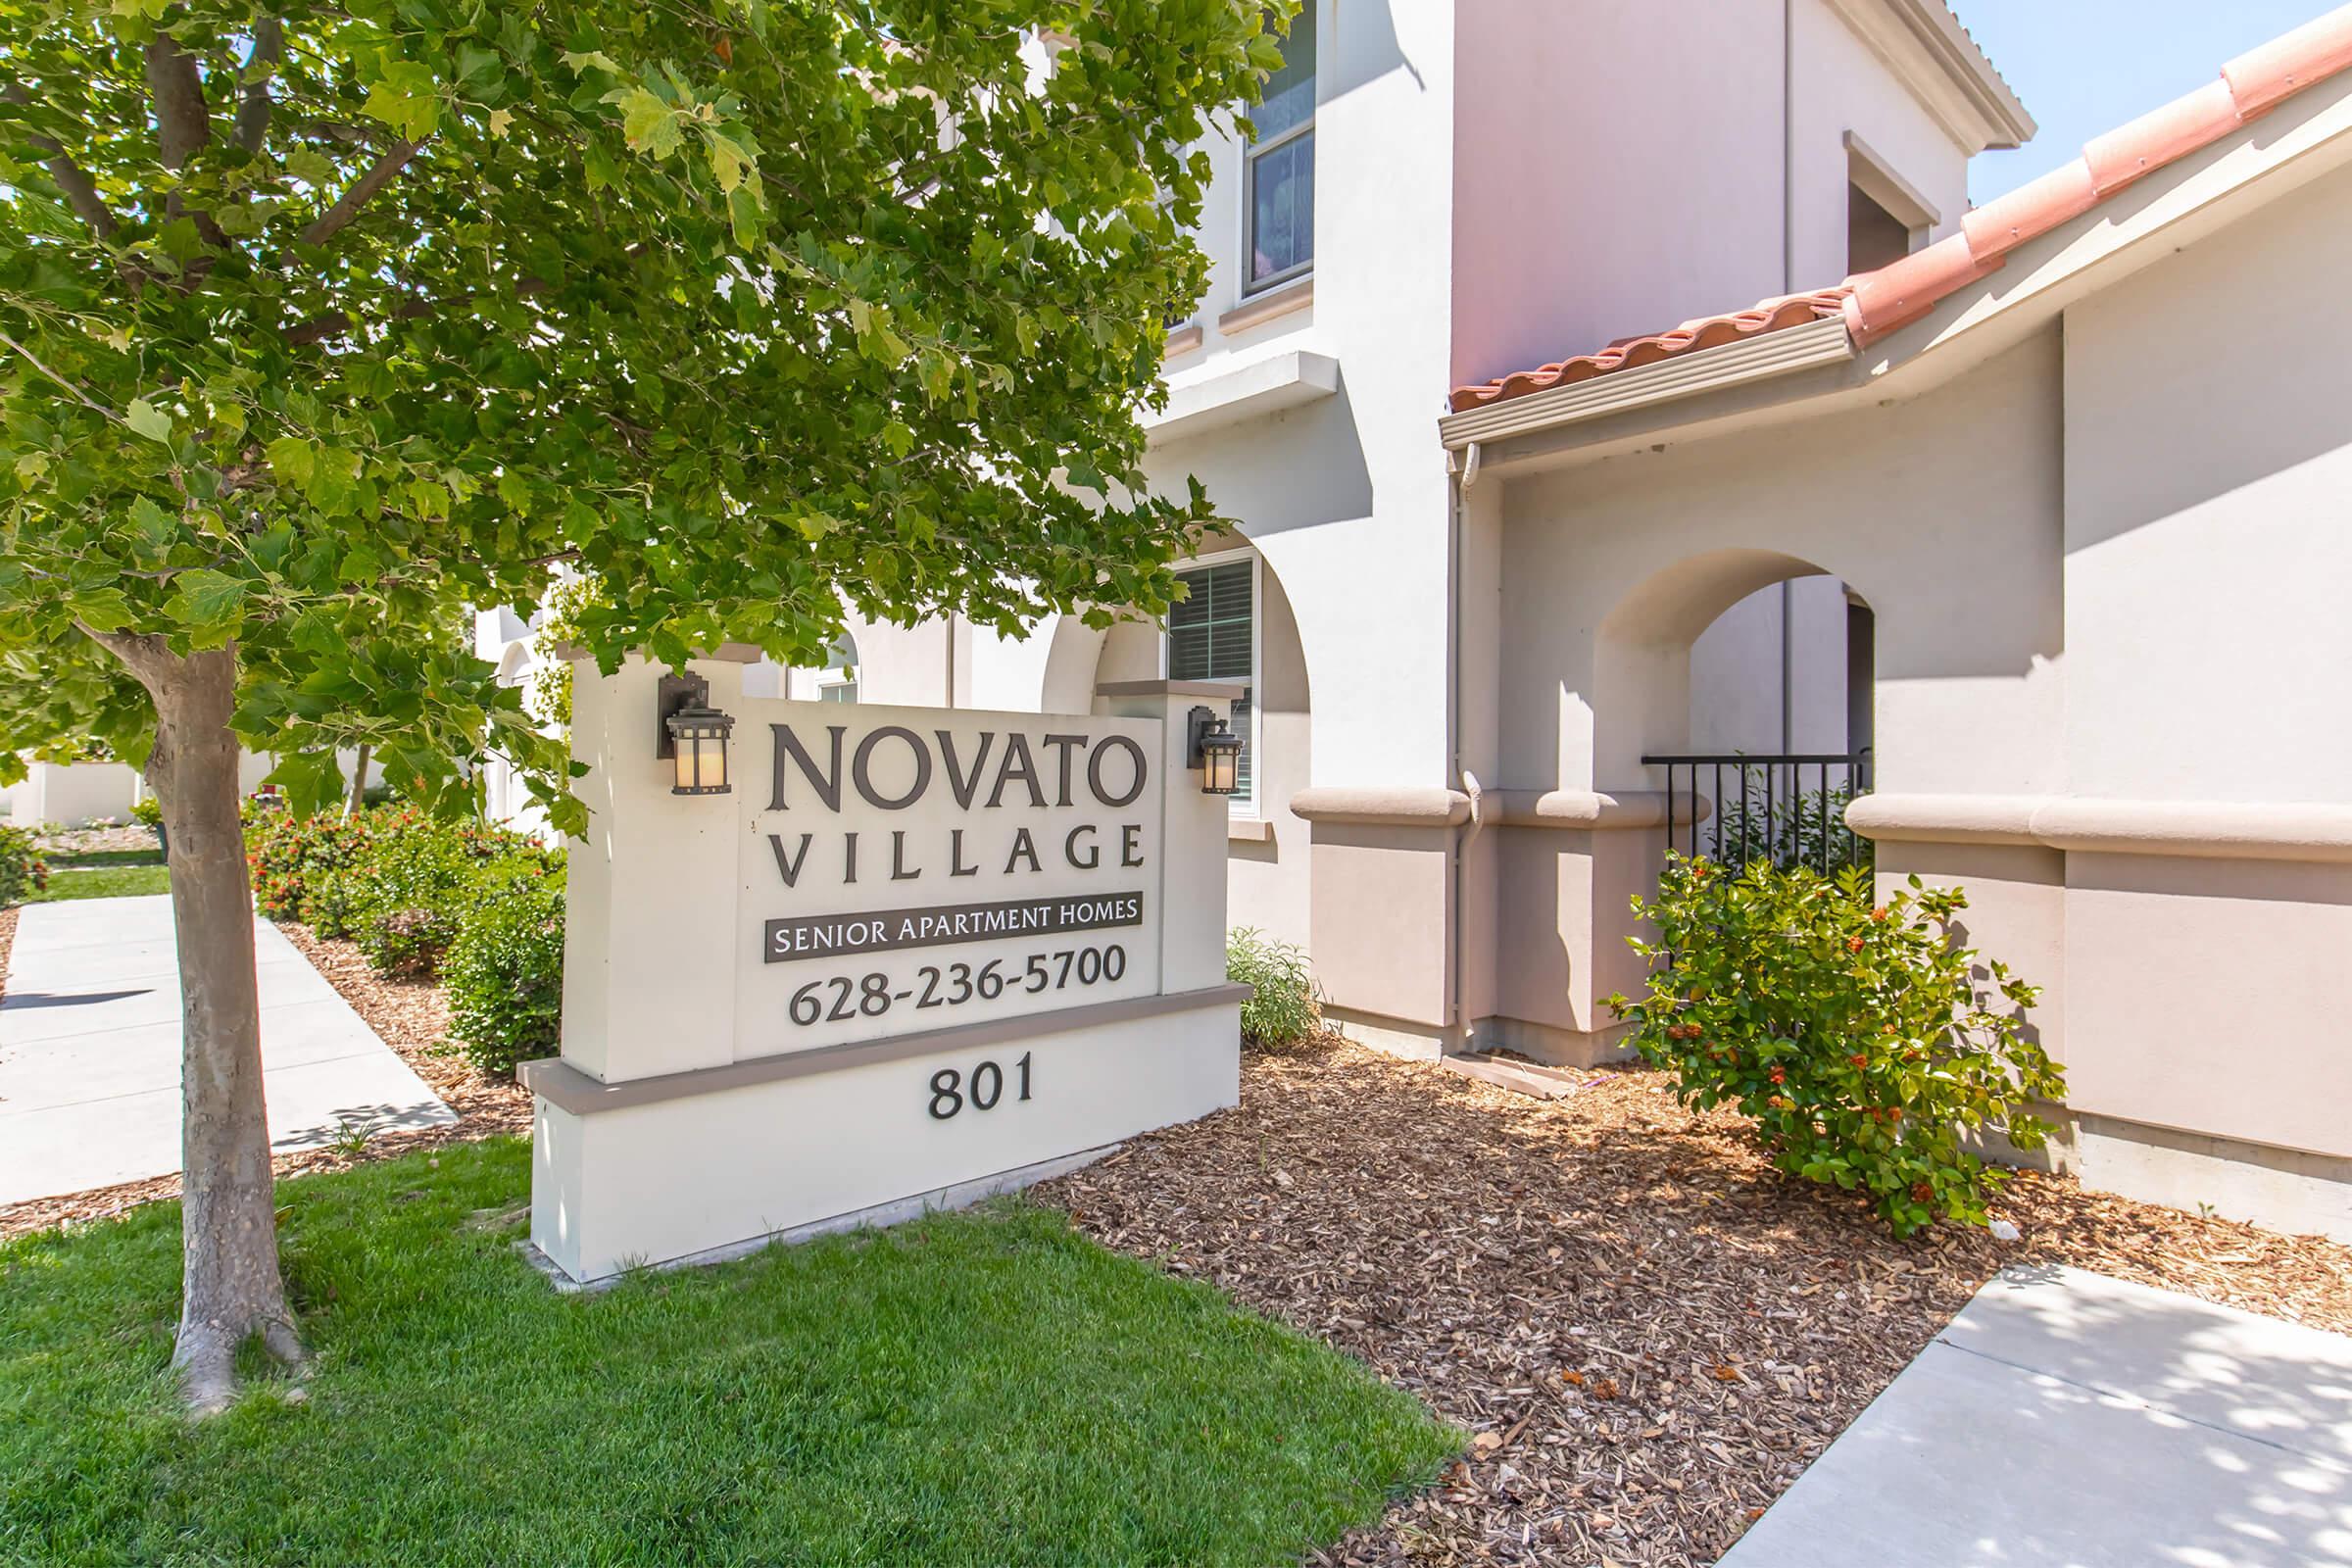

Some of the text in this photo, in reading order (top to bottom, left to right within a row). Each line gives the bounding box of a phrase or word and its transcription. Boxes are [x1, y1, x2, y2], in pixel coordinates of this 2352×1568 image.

[765, 723, 1148, 813] NOVATO
[767, 824, 1145, 888] VILLAGE
[774, 899, 1138, 954] SENIOR APARTMENT HOMES
[789, 944, 1127, 1027] 628-236-5700
[928, 1051, 1033, 1120] 801
